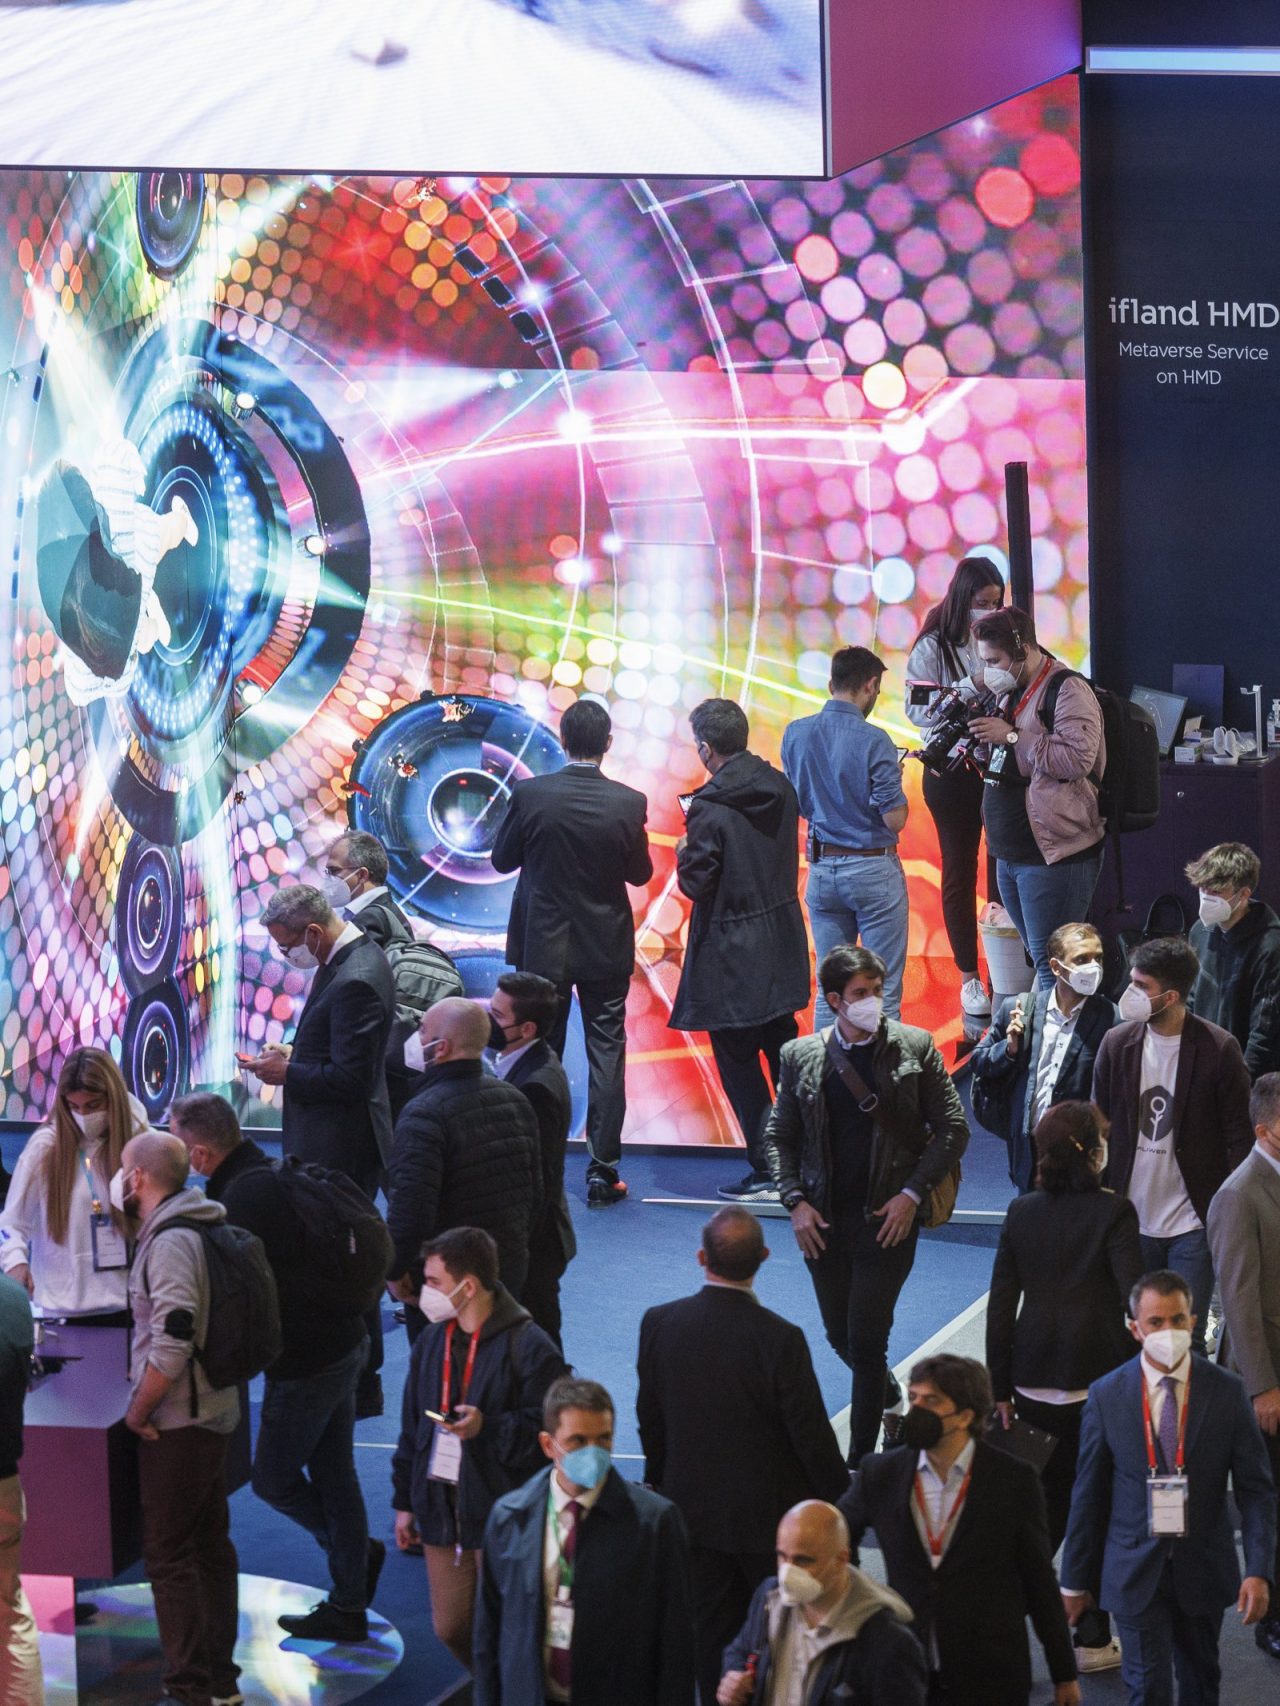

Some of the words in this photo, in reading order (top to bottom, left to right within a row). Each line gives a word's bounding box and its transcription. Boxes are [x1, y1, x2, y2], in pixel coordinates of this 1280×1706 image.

[1109, 297, 1199, 325] ifland
[1208, 302, 1279, 327] HMD
[1120, 342, 1202, 358] Metaverse
[1208, 344, 1268, 360] Service
[1157, 372, 1177, 384] on
[1183, 370, 1221, 384] HMD
